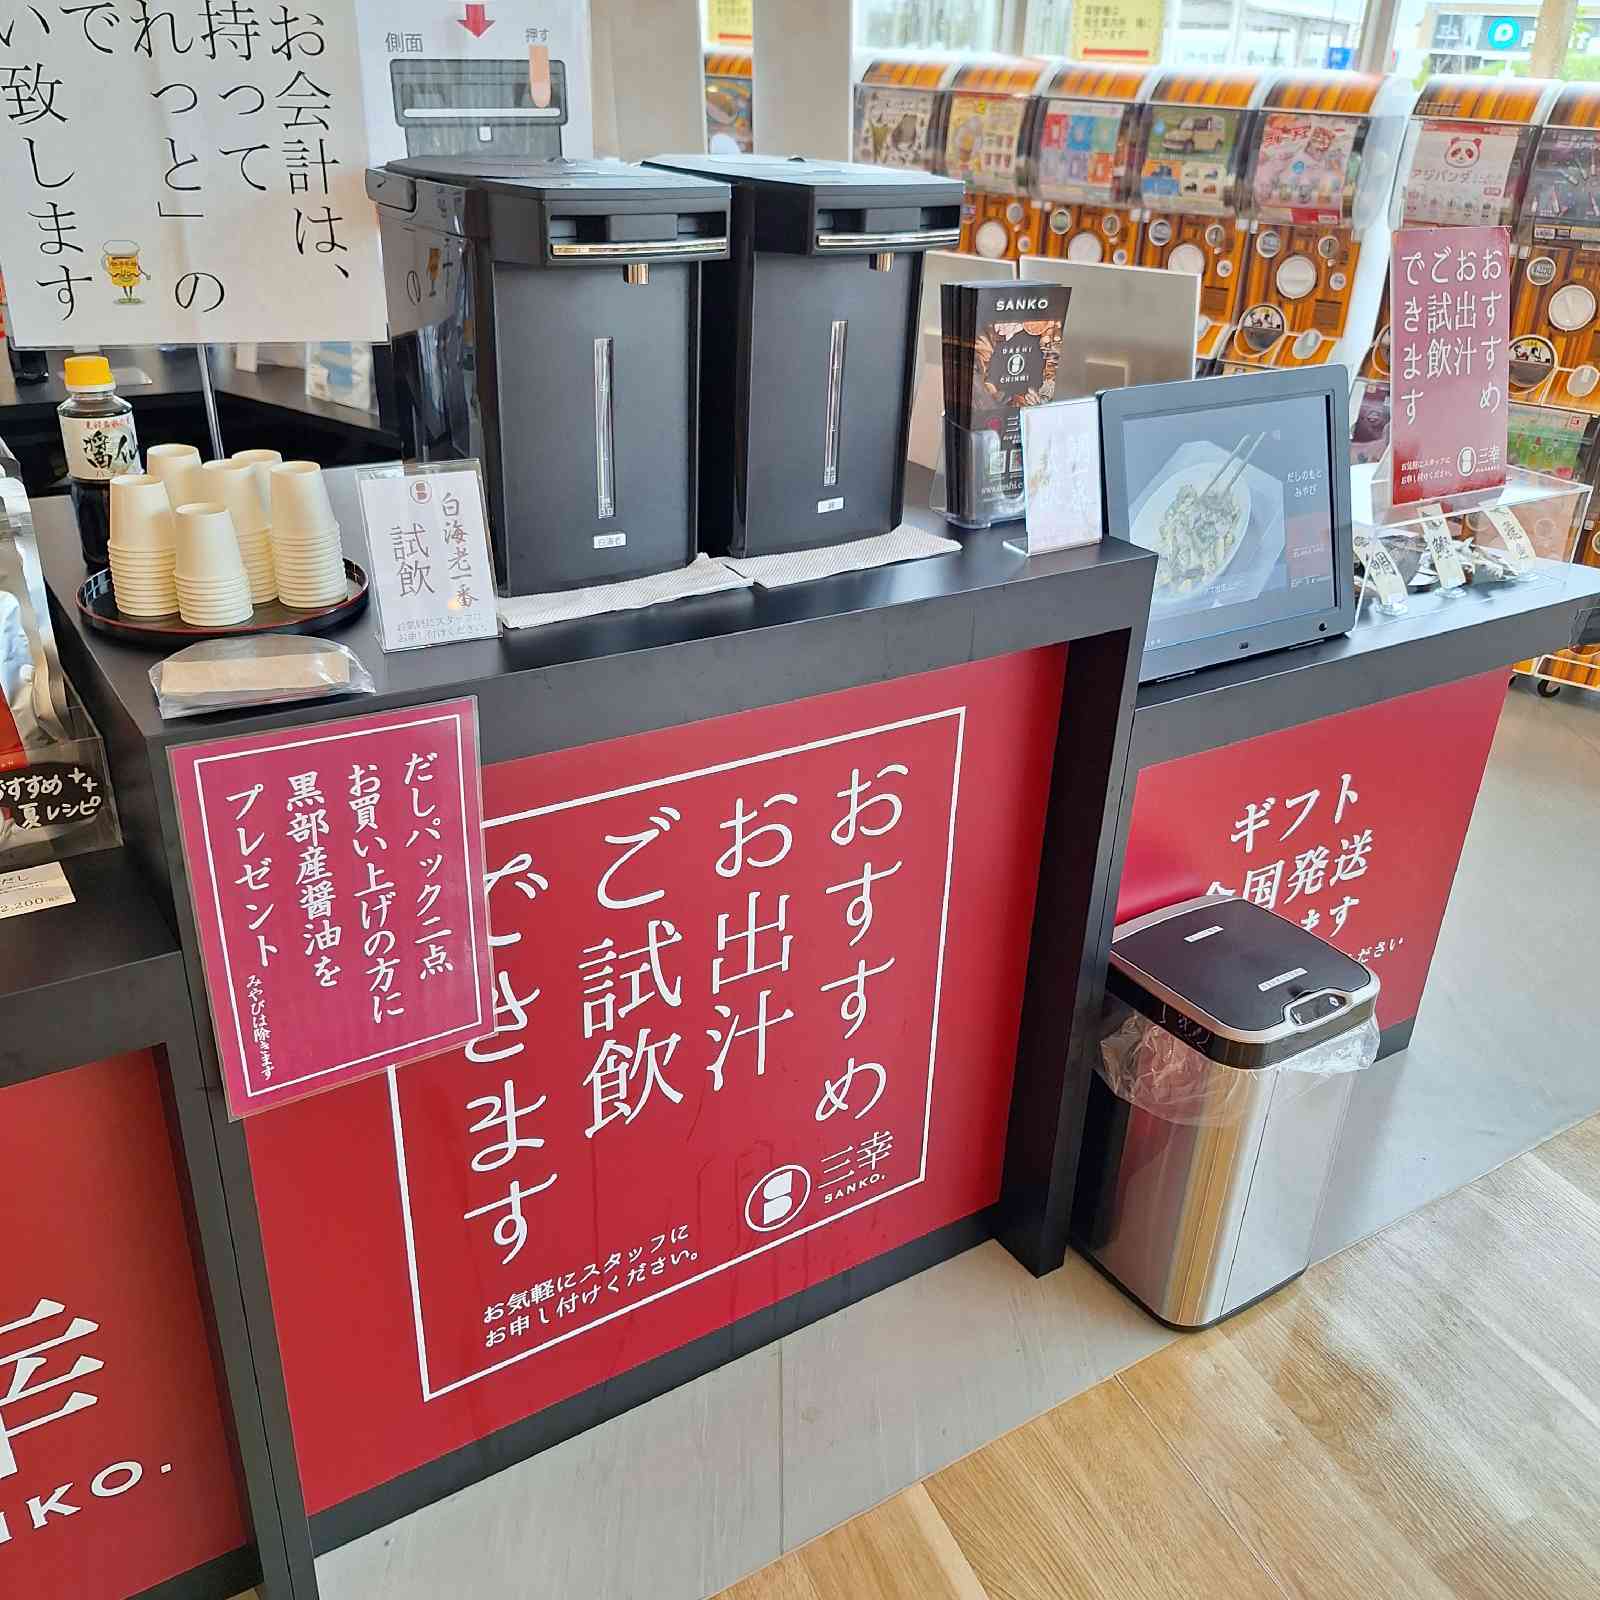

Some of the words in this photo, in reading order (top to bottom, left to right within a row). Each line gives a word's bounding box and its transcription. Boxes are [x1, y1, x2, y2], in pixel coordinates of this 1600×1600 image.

[199, 0, 271, 192] 持って
[384, 31, 424, 53] 側面
[0, 4, 93, 322] い致します
[271, 3, 350, 280] お会計は、
[996, 299, 1049, 312] SANKO
[1401, 252, 1425, 425] できます
[1427, 246, 1452, 379] ご試飲
[1454, 249, 1477, 376] お出汁
[1480, 249, 1503, 415] おすすめ
[389, 522, 436, 597] 試飲
[442, 492, 480, 608] 白海老一番
[18, 796, 102, 830] 夏レシピ
[225, 783, 279, 968] プレゼント
[286, 770, 343, 988] 黒部産醤油を
[404, 752, 456, 981] だしパック二点
[1231, 773, 1359, 853] ギフト
[348, 763, 406, 1025] お買い上げの方に
[705, 792, 798, 1092] お出汁
[814, 764, 909, 1122] おすすめ
[246, 974, 275, 1081] みやびは除きます
[577, 806, 685, 1139] ご試飲
[818, 1131, 894, 1188] 三幸
[824, 1173, 886, 1204] SANKO.
[483, 1224, 689, 1323] お気軽にスタッフに
[485, 1249, 699, 1347] お申し付けください。
